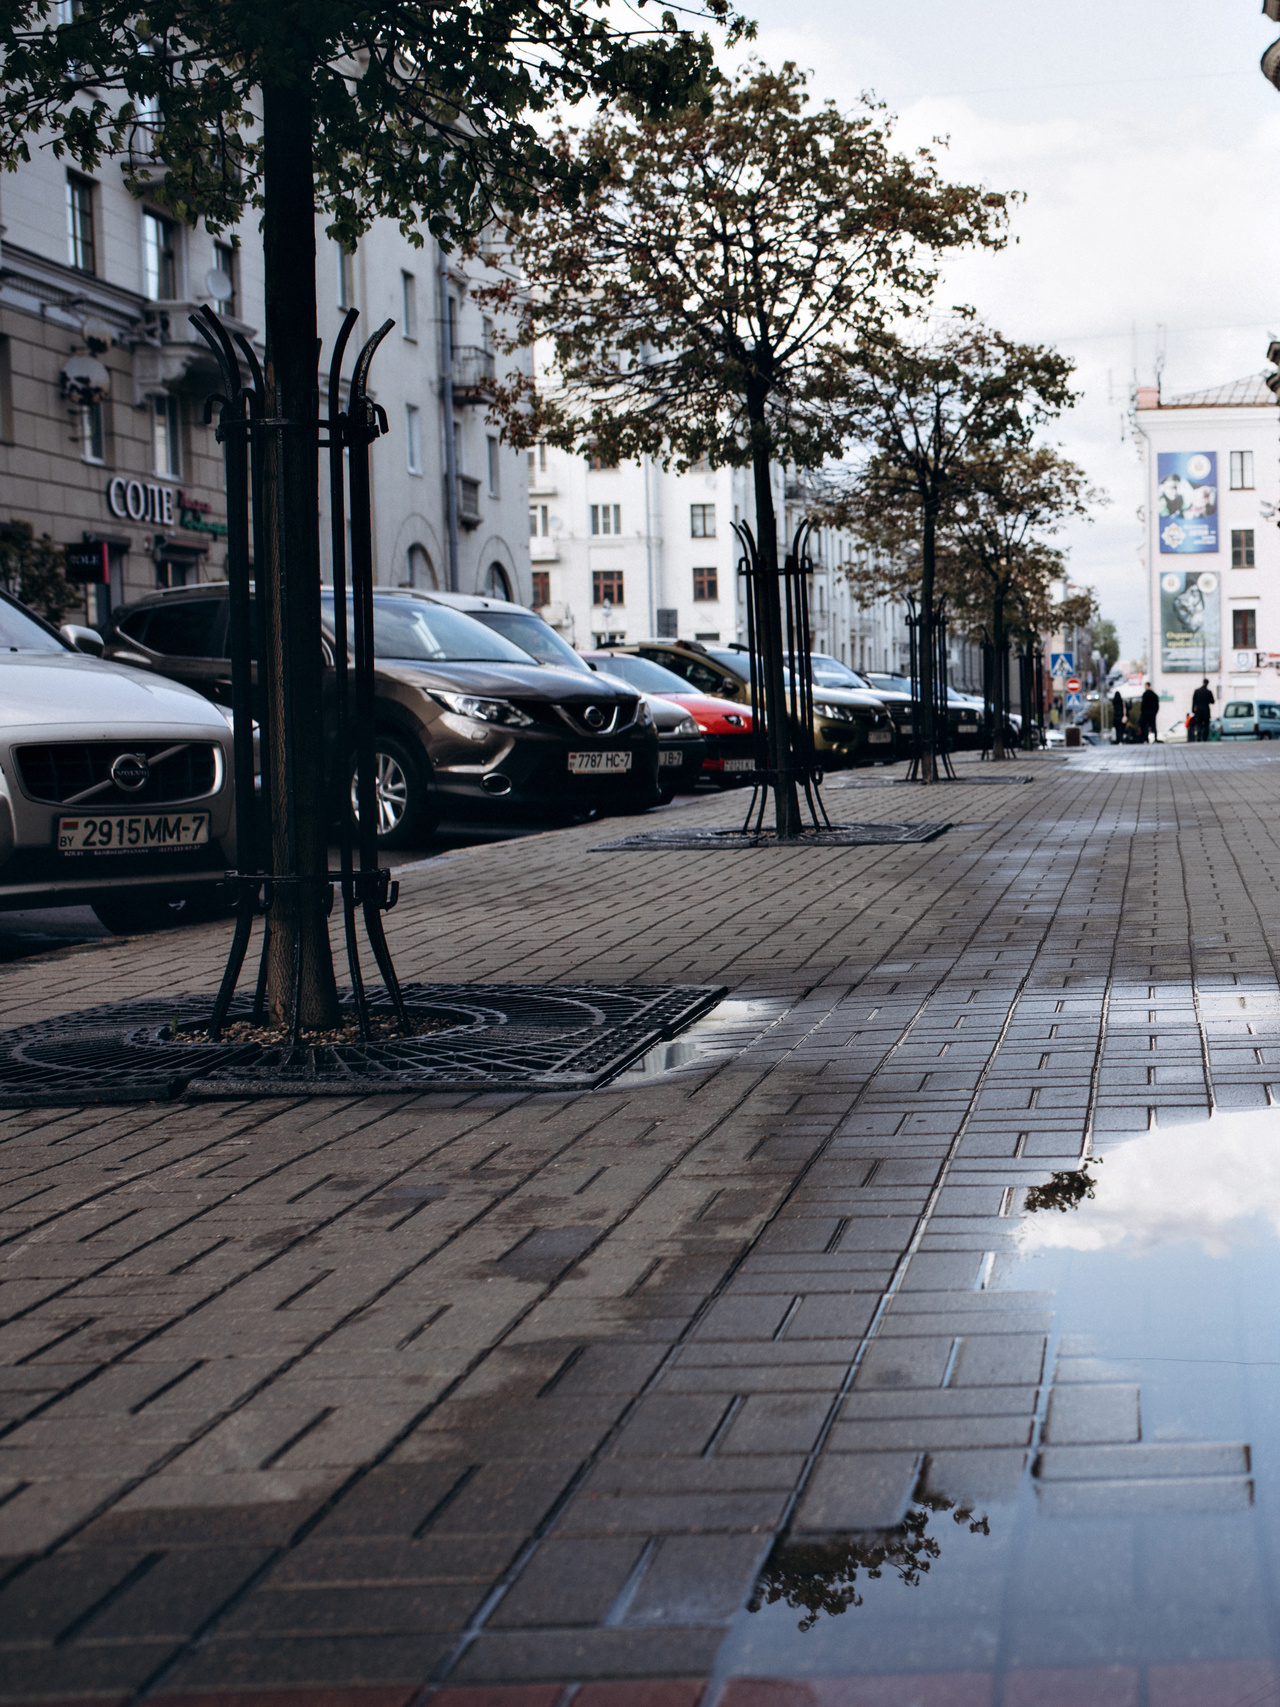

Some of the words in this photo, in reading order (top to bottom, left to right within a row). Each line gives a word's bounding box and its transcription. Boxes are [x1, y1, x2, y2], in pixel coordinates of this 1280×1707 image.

[109, 477, 174, 525] СОЛЕ
[578, 754, 602, 768] 7787
[605, 753, 630, 768] HC-7
[60, 837, 74, 847] BY
[82, 816, 205, 847] 2915MM-7
